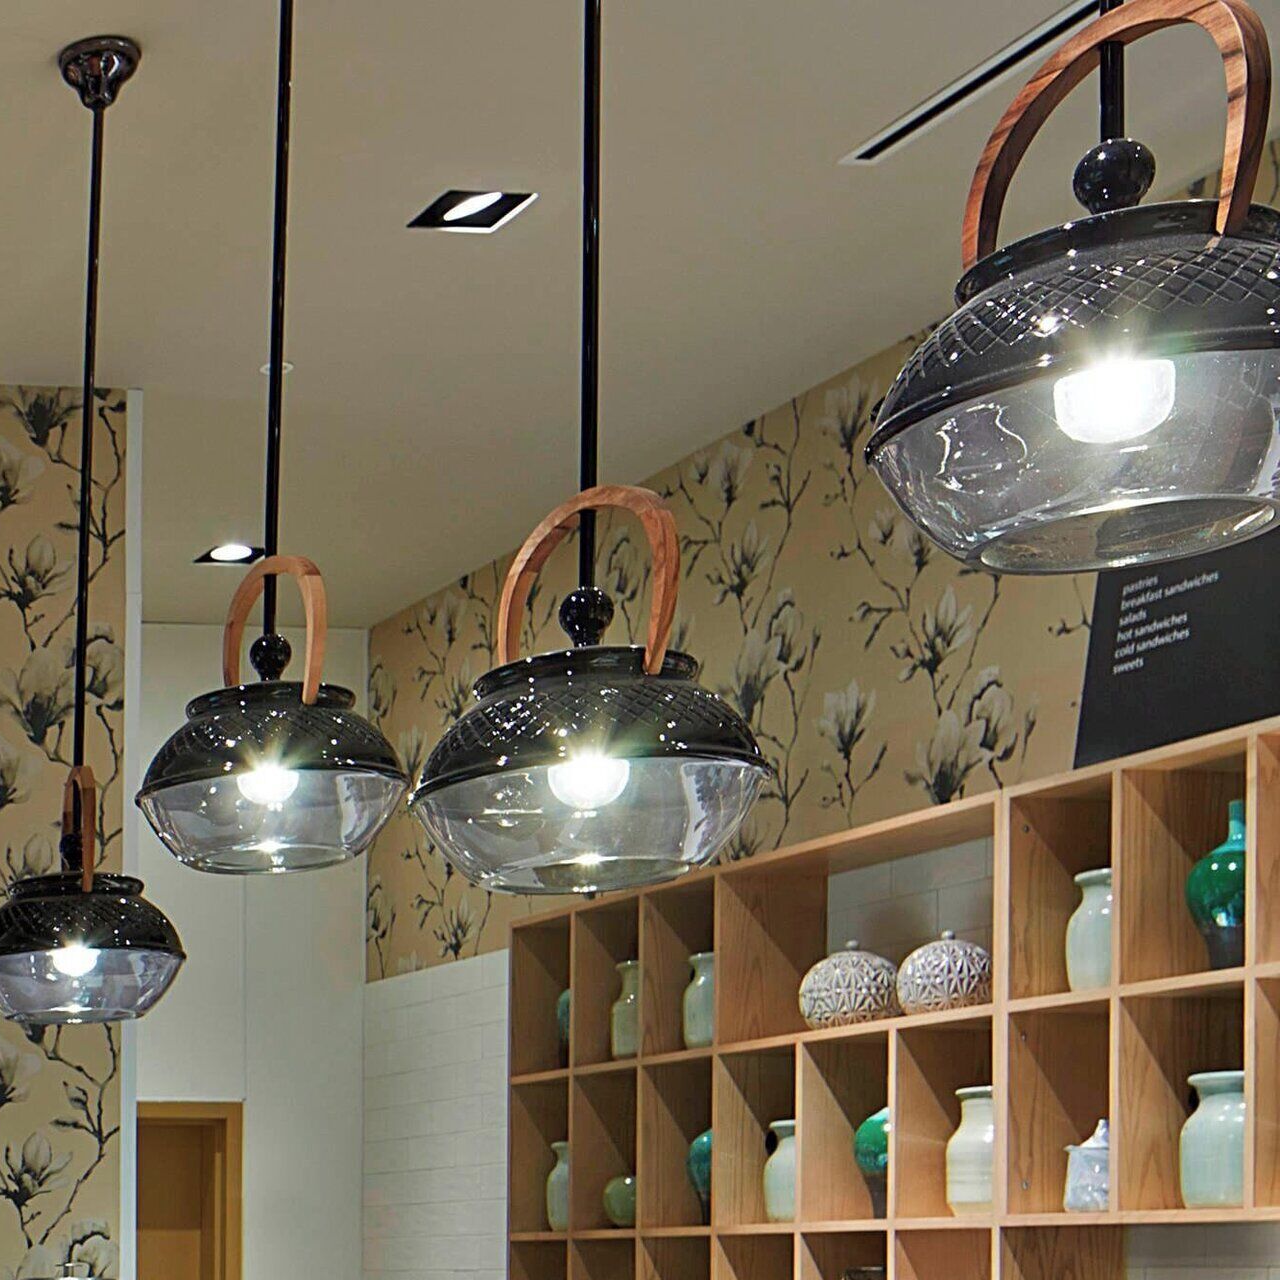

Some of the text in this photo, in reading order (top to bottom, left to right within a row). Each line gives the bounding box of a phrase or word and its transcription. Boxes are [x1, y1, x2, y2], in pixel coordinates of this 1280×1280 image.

[1120, 570, 1220, 612] breakfast sandwiches
[1122, 575, 1159, 597] pastries
[1116, 612, 1188, 643] hot sandwiches
[1118, 609, 1147, 627] salads
[1114, 627, 1191, 659] cold sandwiches
[1112, 657, 1145, 676] sweets
